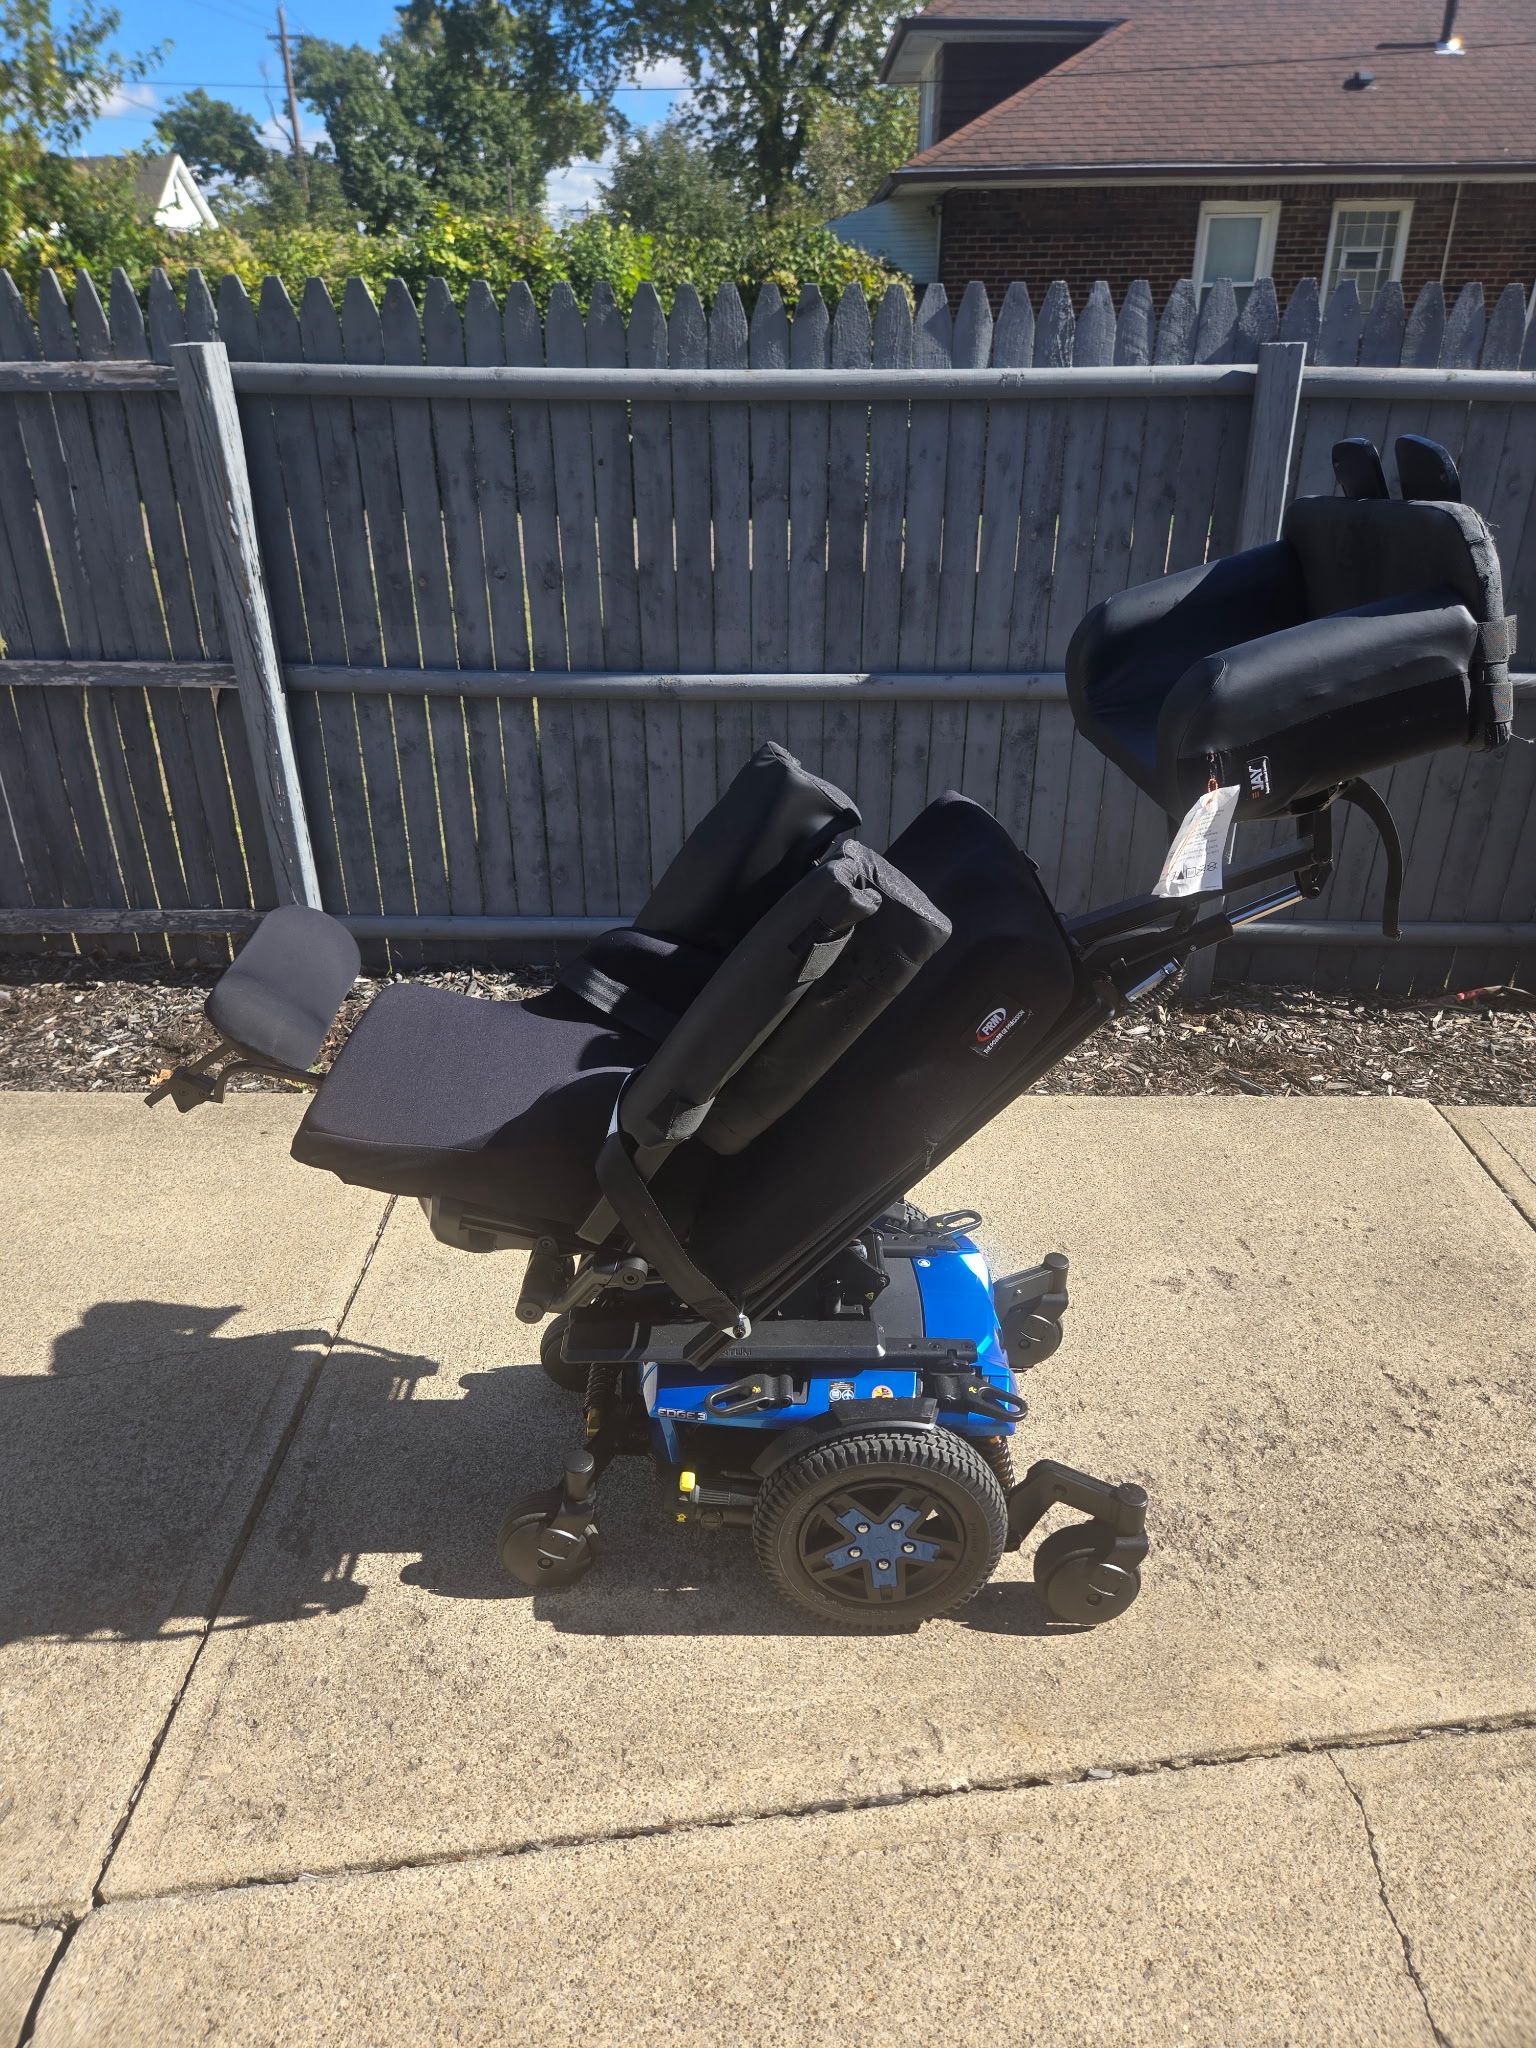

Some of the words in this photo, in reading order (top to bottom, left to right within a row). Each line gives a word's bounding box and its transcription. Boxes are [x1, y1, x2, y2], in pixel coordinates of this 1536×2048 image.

[1248, 765, 1264, 791] JAY
[981, 1013, 1003, 1036] PRM
[657, 1408, 696, 1420] EDGE
[697, 1411, 707, 1421] 3
